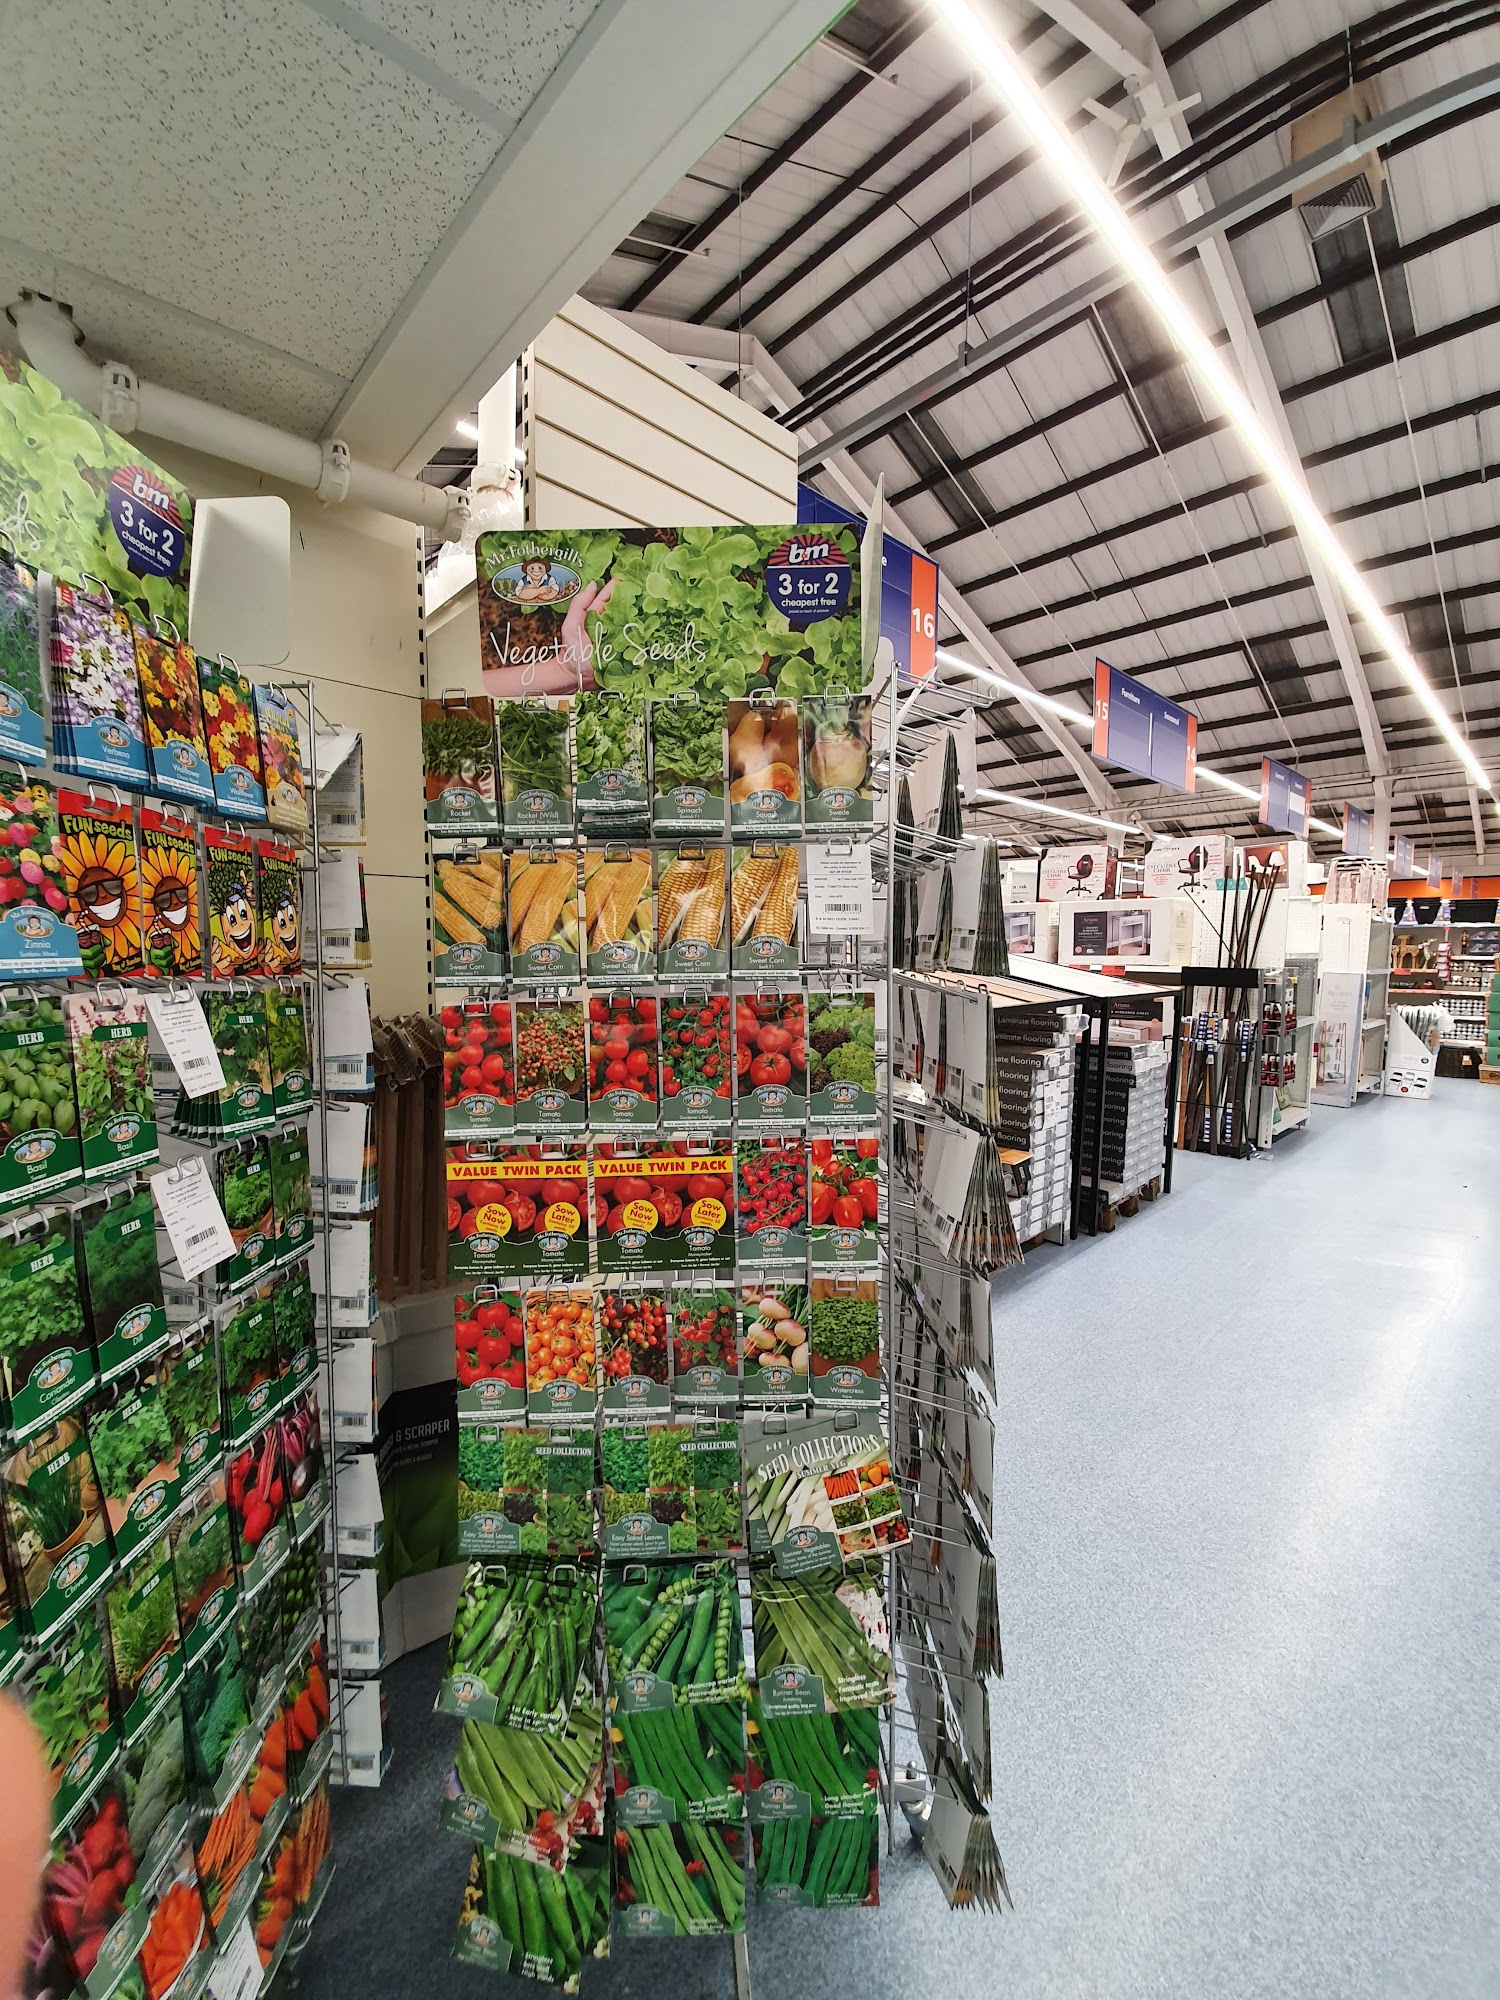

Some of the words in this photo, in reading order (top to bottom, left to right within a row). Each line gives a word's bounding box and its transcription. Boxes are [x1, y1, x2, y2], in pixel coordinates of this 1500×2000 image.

[120, 501, 133, 528] 3
[138, 519, 159, 544] for
[161, 529, 174, 556] 2
[121, 530, 156, 555] cheapest
[156, 551, 171, 567] free
[778, 573, 792, 595] 3
[798, 579, 820, 595] for
[825, 572, 839, 594] 2
[781, 598, 819, 609] cheapest
[820, 597, 837, 606] free
[911, 607, 935, 638] 16
[490, 621, 617, 686] Vegetable
[623, 621, 708, 666] Seeds
[1121, 688, 1140, 704] Furniture
[1096, 700, 1108, 720] 15
[1164, 711, 1180, 726] Seasonal
[102, 745, 130, 759] Verbena
[1187, 746, 1196, 762] 14
[599, 788, 626, 797] Spinach
[538, 811, 559, 819] (Wild)
[677, 807, 703, 815] Spinach
[755, 811, 778, 819] Squash
[62, 814, 93, 836] FUN
[93, 820, 133, 842] seeds
[144, 829, 168, 849] FUN
[167, 835, 196, 855] seeds
[209, 845, 228, 861] FUN
[227, 850, 252, 866] seeds
[262, 855, 279, 871] FUN
[277, 858, 298, 873] seeds
[24, 939, 51, 949] Zinnia
[748, 956, 767, 964] Sweet
[528, 964, 546, 972] Sweet
[548, 962, 565, 970] Corn
[238, 1015, 254, 1024] HERB
[998, 1016, 1029, 1026] Laminate
[1030, 1016, 1059, 1030] flooring
[17, 1031, 45, 1046] HERB
[110, 1027, 133, 1039] HERB
[1022, 1033, 1052, 1045] flooring
[1010, 1054, 1042, 1069] flooring
[1000, 1070, 1030, 1083] flooring
[999, 1085, 1029, 1099] flooring
[237, 1107, 261, 1116] Coriander
[686, 1107, 709, 1115] Tomato
[761, 1106, 783, 1114] Tomato
[999, 1100, 1028, 1114] flooring
[538, 1110, 561, 1118] Tomato
[612, 1110, 634, 1118] Tomato
[997, 1131, 1027, 1146] flooring
[117, 1140, 133, 1152] Basil
[27, 1160, 48, 1174] Basil
[452, 1165, 497, 1177] VALUE
[502, 1164, 540, 1176] TWIN
[545, 1164, 582, 1175] PACK
[599, 1162, 644, 1174] VALUE
[648, 1161, 686, 1173] TWIN
[691, 1159, 727, 1171] PACK
[486, 1205, 507, 1217] Sow
[555, 1204, 575, 1216] Sow
[633, 1202, 654, 1213] Sow
[701, 1199, 722, 1211] Sow
[483, 1212, 506, 1225] Now
[551, 1211, 575, 1224] Later
[630, 1209, 653, 1221] Now
[698, 1206, 721, 1219] Later
[120, 1219, 142, 1236] HERB
[473, 1251, 496, 1259] Tomato
[541, 1250, 565, 1258] Tomato
[30, 1253, 54, 1273] HERB
[39, 1375, 76, 1404] Coriander
[695, 1384, 718, 1392] Tomato
[767, 1383, 786, 1391] Turnip
[830, 1386, 864, 1394] Watercress
[480, 1398, 502, 1406] Tomato
[550, 1400, 573, 1408] Tomato
[625, 1395, 647, 1403] Tomato
[122, 1398, 142, 1420] HERB
[404, 1419, 450, 1441] SCRAPER
[680, 1442, 696, 1451] SEED
[697, 1440, 737, 1450] COLLECTION
[535, 1447, 552, 1455] SEED
[552, 1447, 592, 1457] COLLECTION
[47, 1451, 71, 1477] HERB
[757, 1452, 789, 1483] SEED
[791, 1434, 881, 1467] COLLECTIONS
[796, 1464, 830, 1479] SUMMER
[831, 1460, 846, 1470] VEG
[137, 1504, 168, 1533] Oregano
[463, 1530, 477, 1539] Easy
[611, 1534, 625, 1543] Easy
[782, 1551, 802, 1560] Summer
[802, 1543, 831, 1555] Vegetables
[64, 1574, 89, 1598] Chives
[837, 1674, 867, 1684] Stringless
[687, 1681, 717, 1691] Maincrop
[838, 1684, 864, 1695] Fantastic
[864, 1679, 880, 1689] taste
[772, 1689, 792, 1697] Runner
[840, 1692, 868, 1703] Improved
[824, 1795, 839, 1804] Long
[840, 1793, 862, 1801] slender
[842, 1800, 864, 1809] flavour
[689, 1806, 706, 1814] Good
[706, 1803, 728, 1813] flavour
[761, 1801, 781, 1810] Runner
